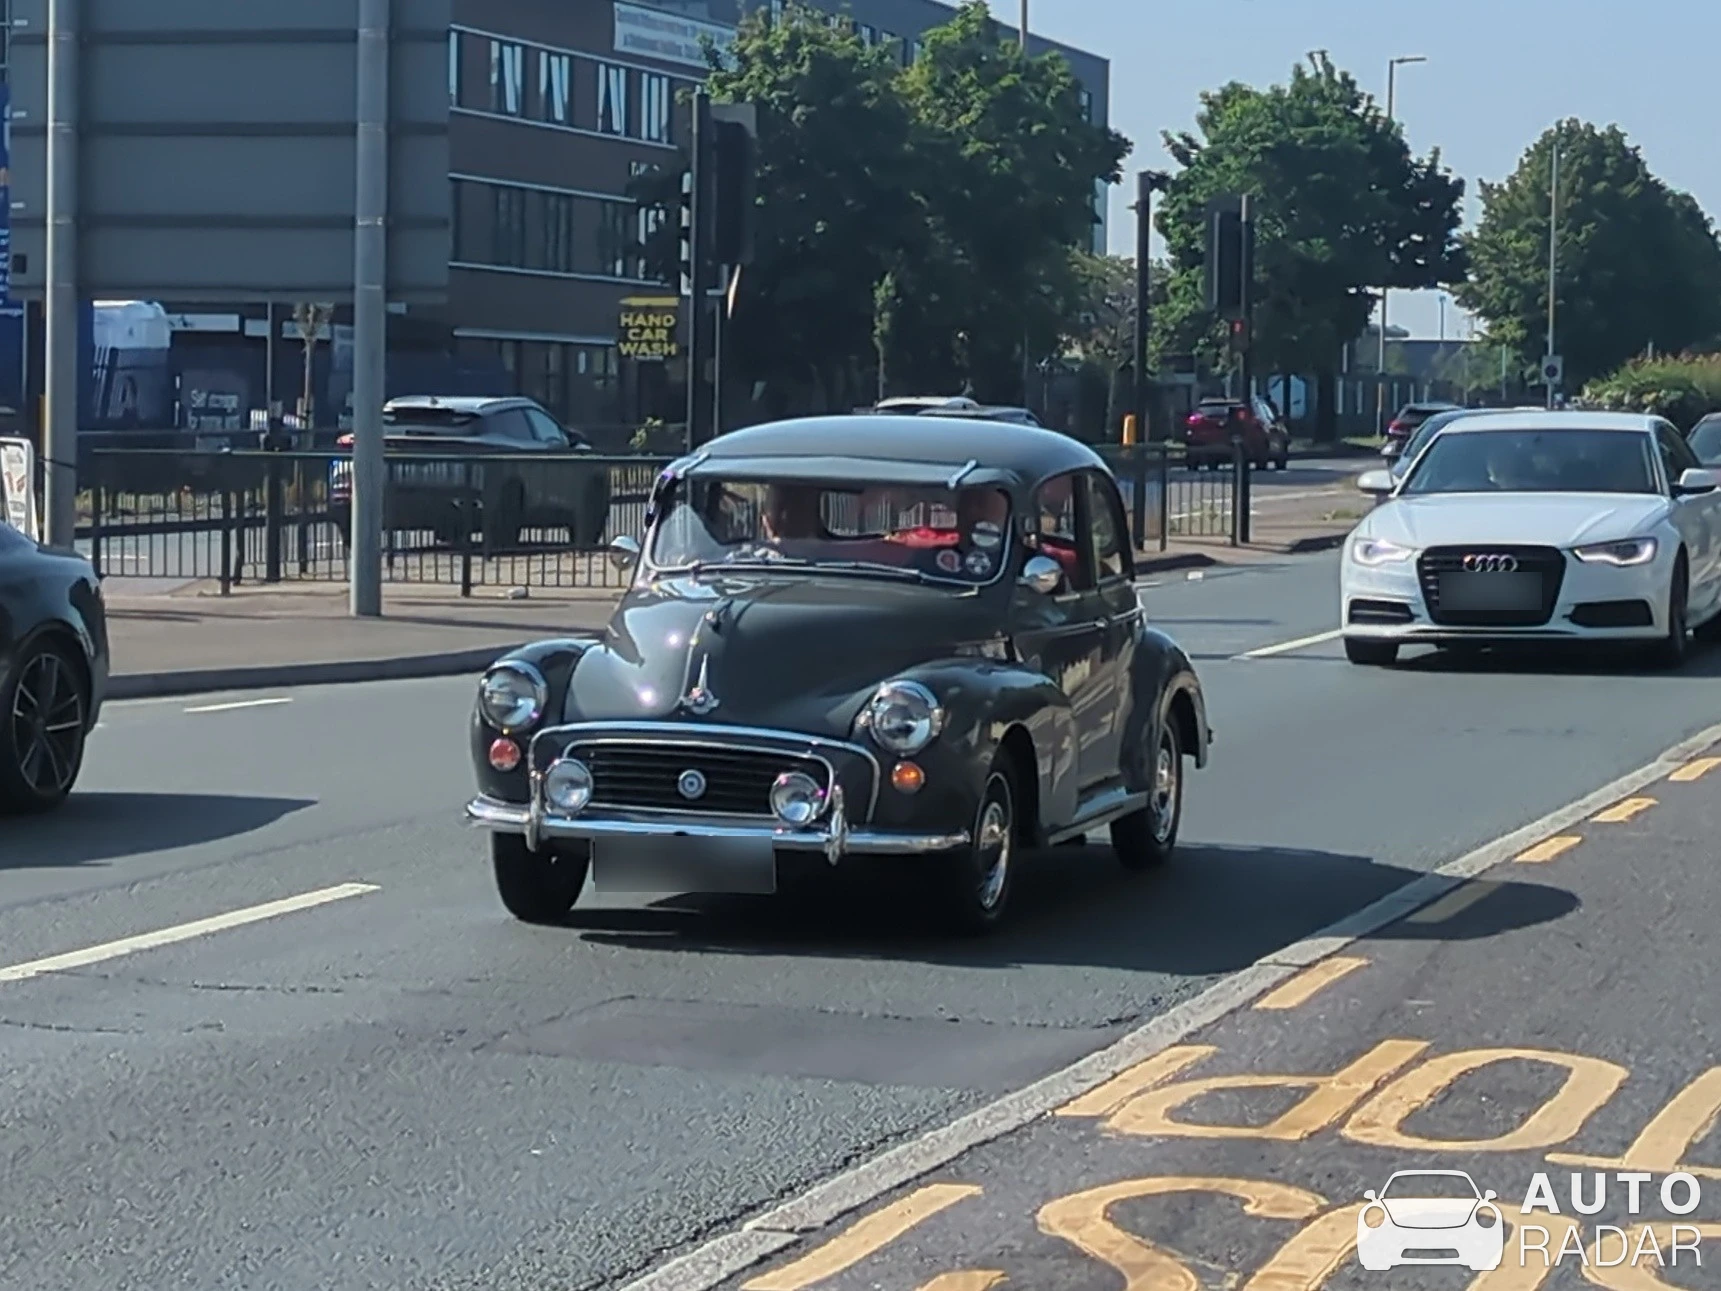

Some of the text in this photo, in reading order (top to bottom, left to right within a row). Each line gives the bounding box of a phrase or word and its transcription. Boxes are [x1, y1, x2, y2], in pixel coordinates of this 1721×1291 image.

[620, 312, 676, 327] HAND
[627, 328, 668, 341] CAR
[618, 342, 677, 356] WASH
